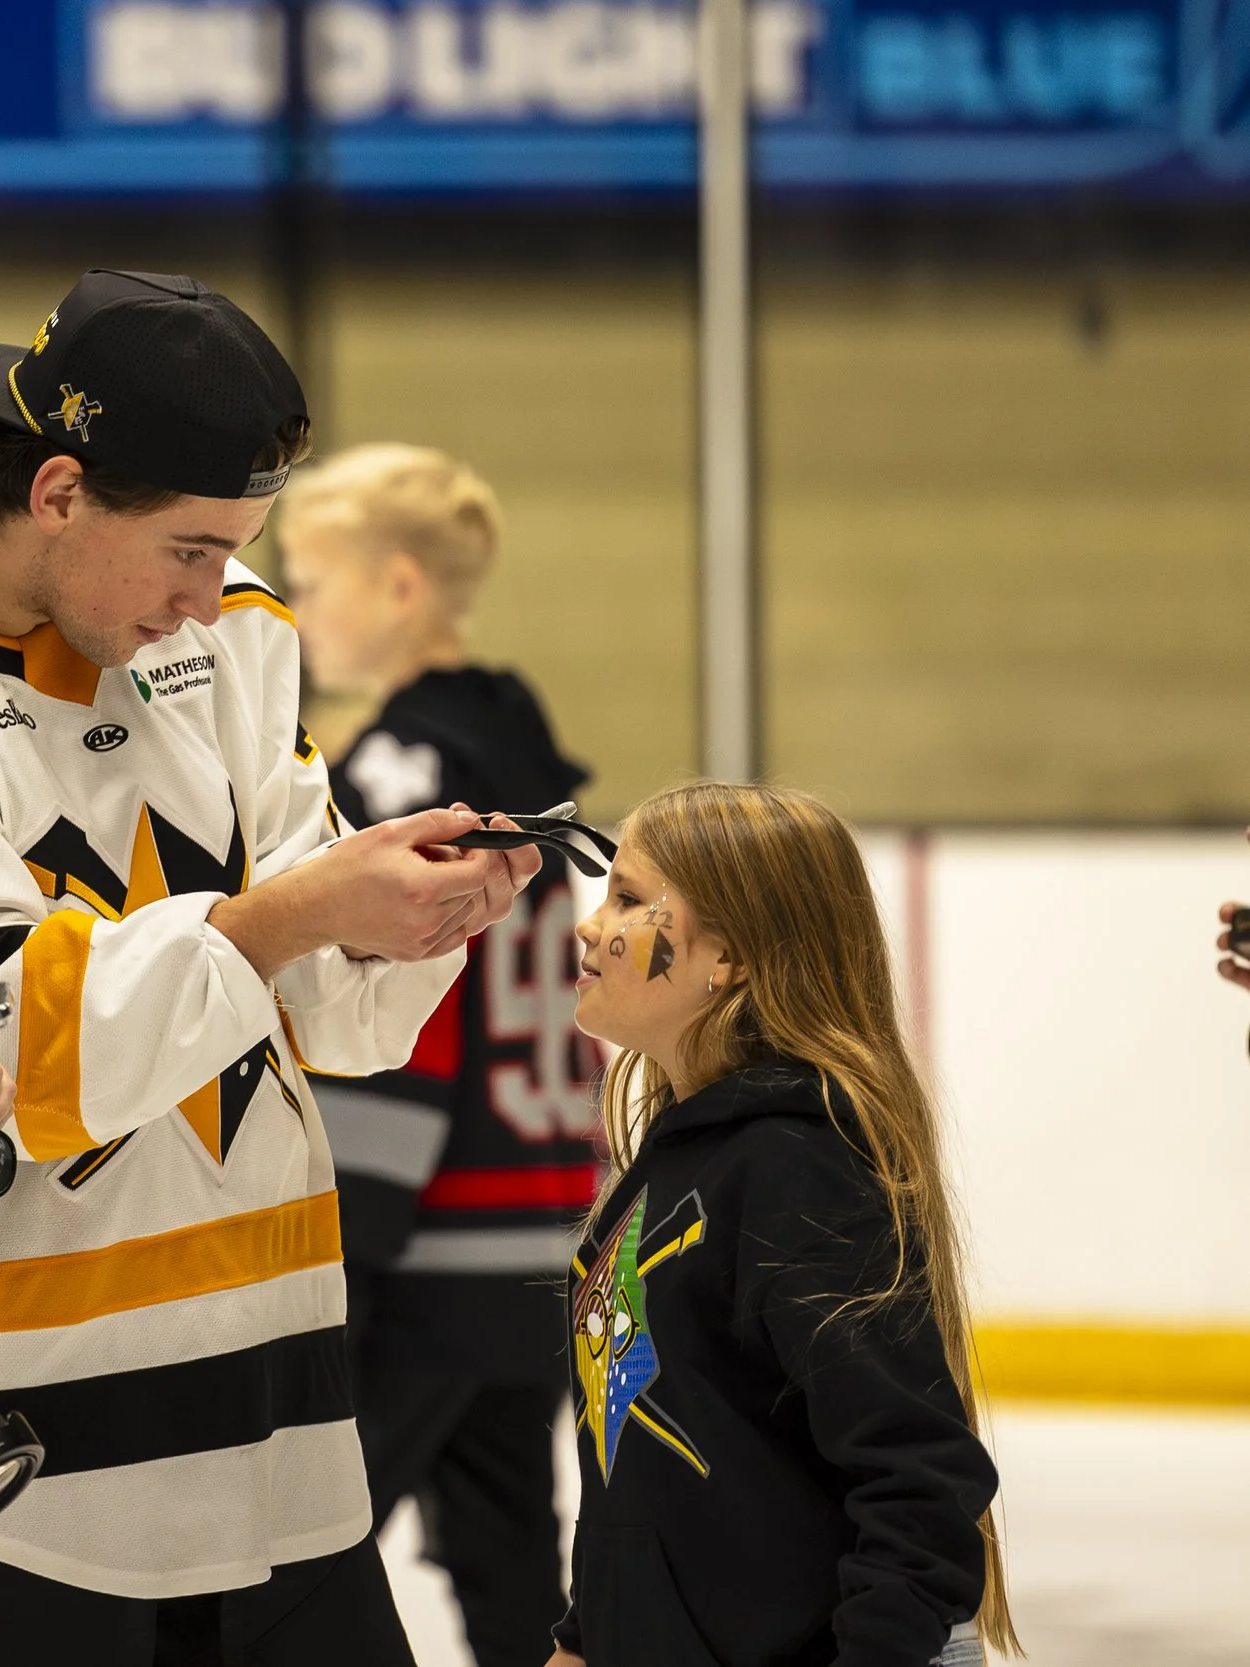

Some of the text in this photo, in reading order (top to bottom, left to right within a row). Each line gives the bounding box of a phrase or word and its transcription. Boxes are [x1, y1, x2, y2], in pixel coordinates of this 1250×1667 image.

[860, 12, 1160, 120] BLUE
[148, 655, 215, 684] MATHESON
[168, 683, 184, 695] Gas
